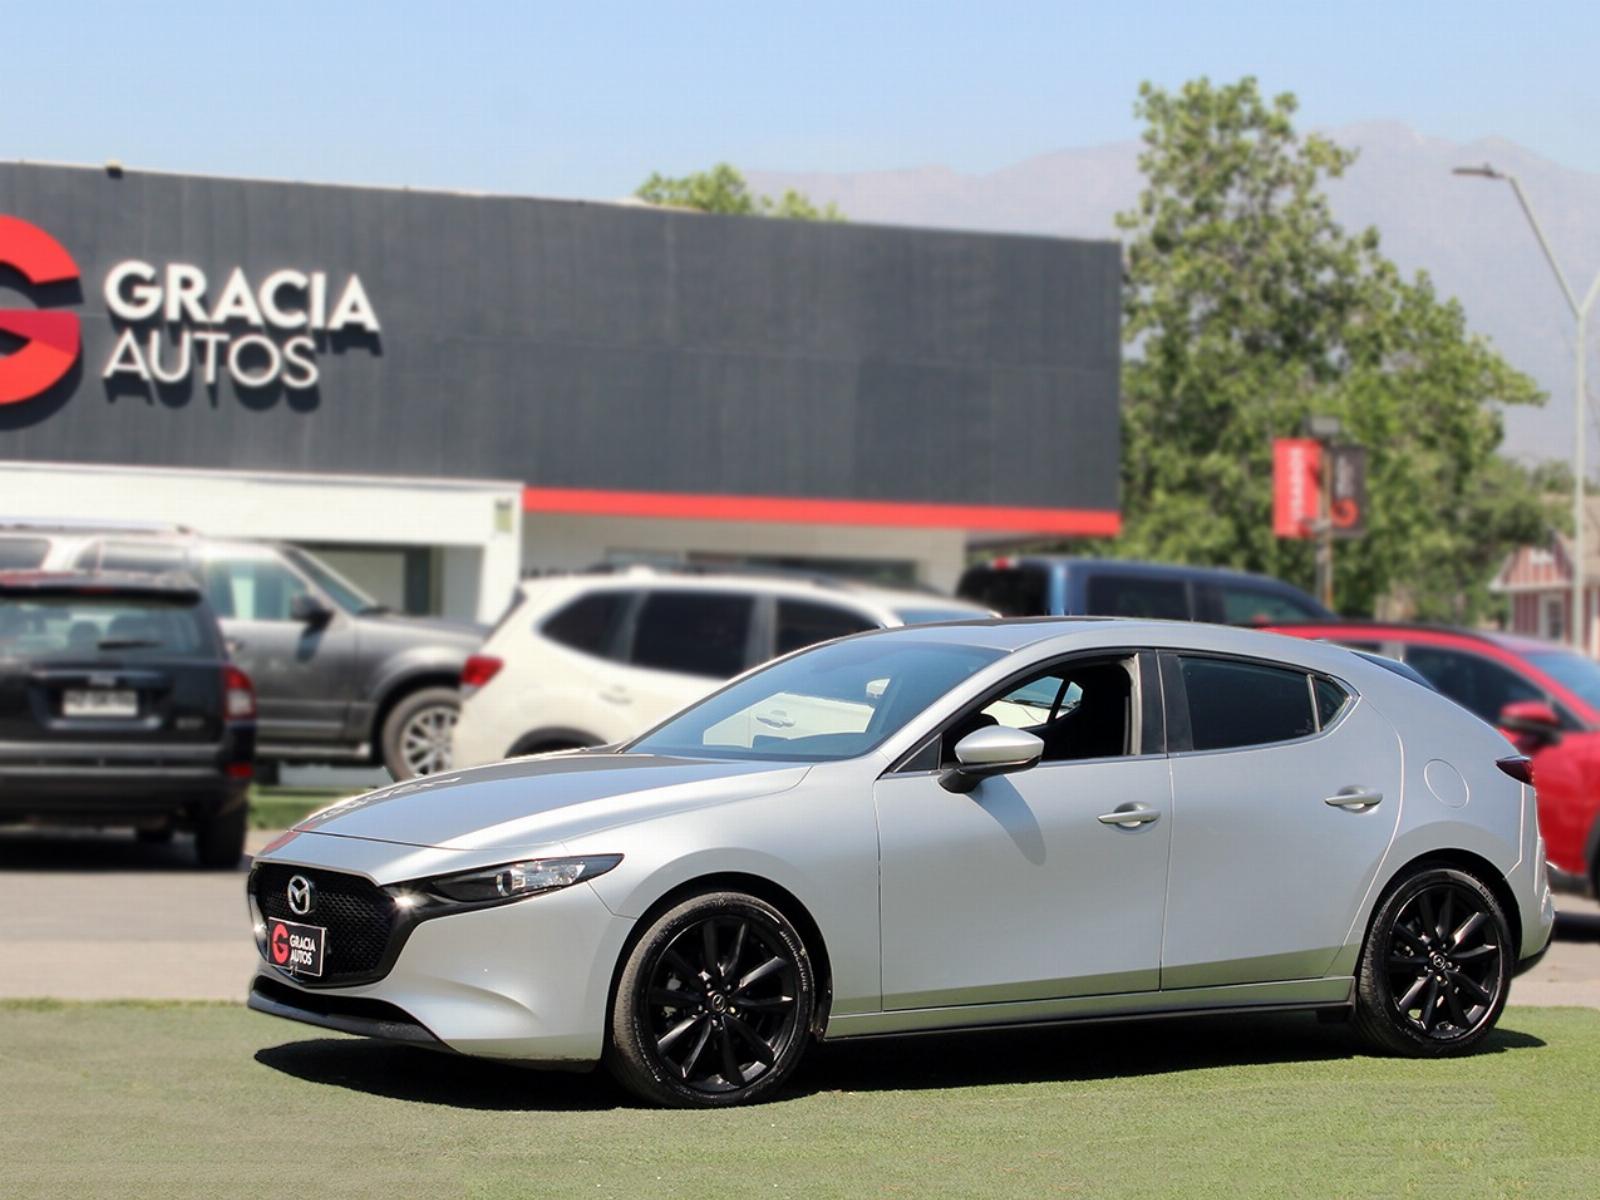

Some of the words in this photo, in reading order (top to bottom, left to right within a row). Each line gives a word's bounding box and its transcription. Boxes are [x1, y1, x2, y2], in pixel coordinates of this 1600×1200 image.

[104, 259, 381, 333] GRACIA
[103, 328, 320, 388] AUTOS
[289, 934, 316, 952] GRACIA
[290, 949, 312, 965] AUTOS
